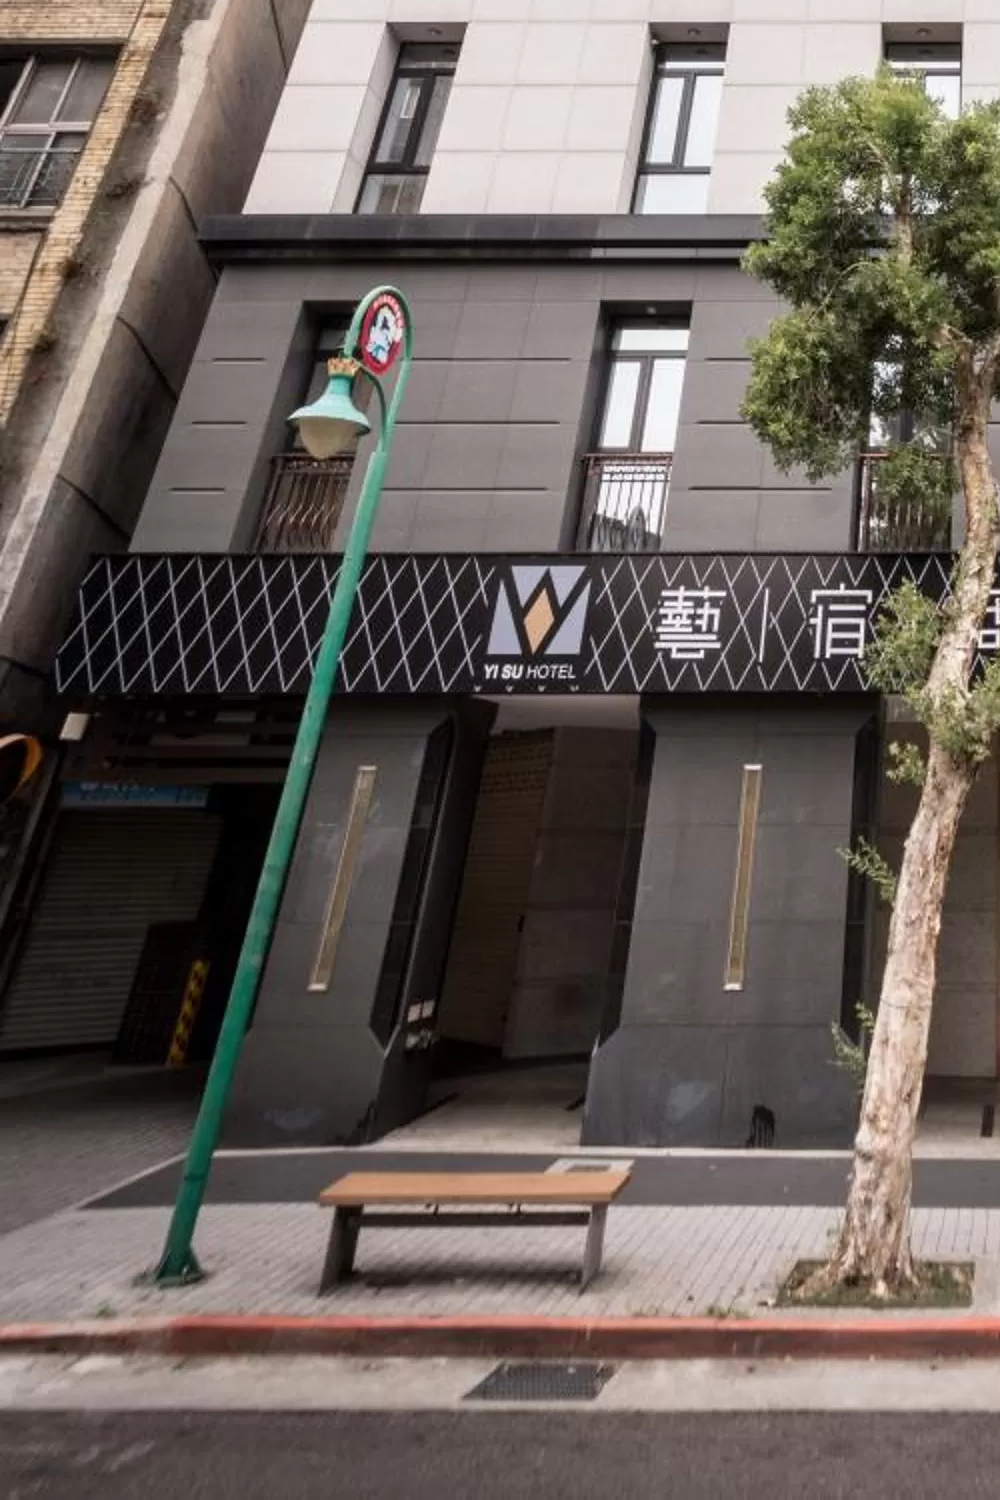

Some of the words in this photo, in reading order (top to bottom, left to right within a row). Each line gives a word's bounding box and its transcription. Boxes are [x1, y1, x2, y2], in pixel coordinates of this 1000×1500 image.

[484, 664, 499, 679] YI
[501, 664, 523, 679] SU
[525, 664, 576, 679] HOTEL
